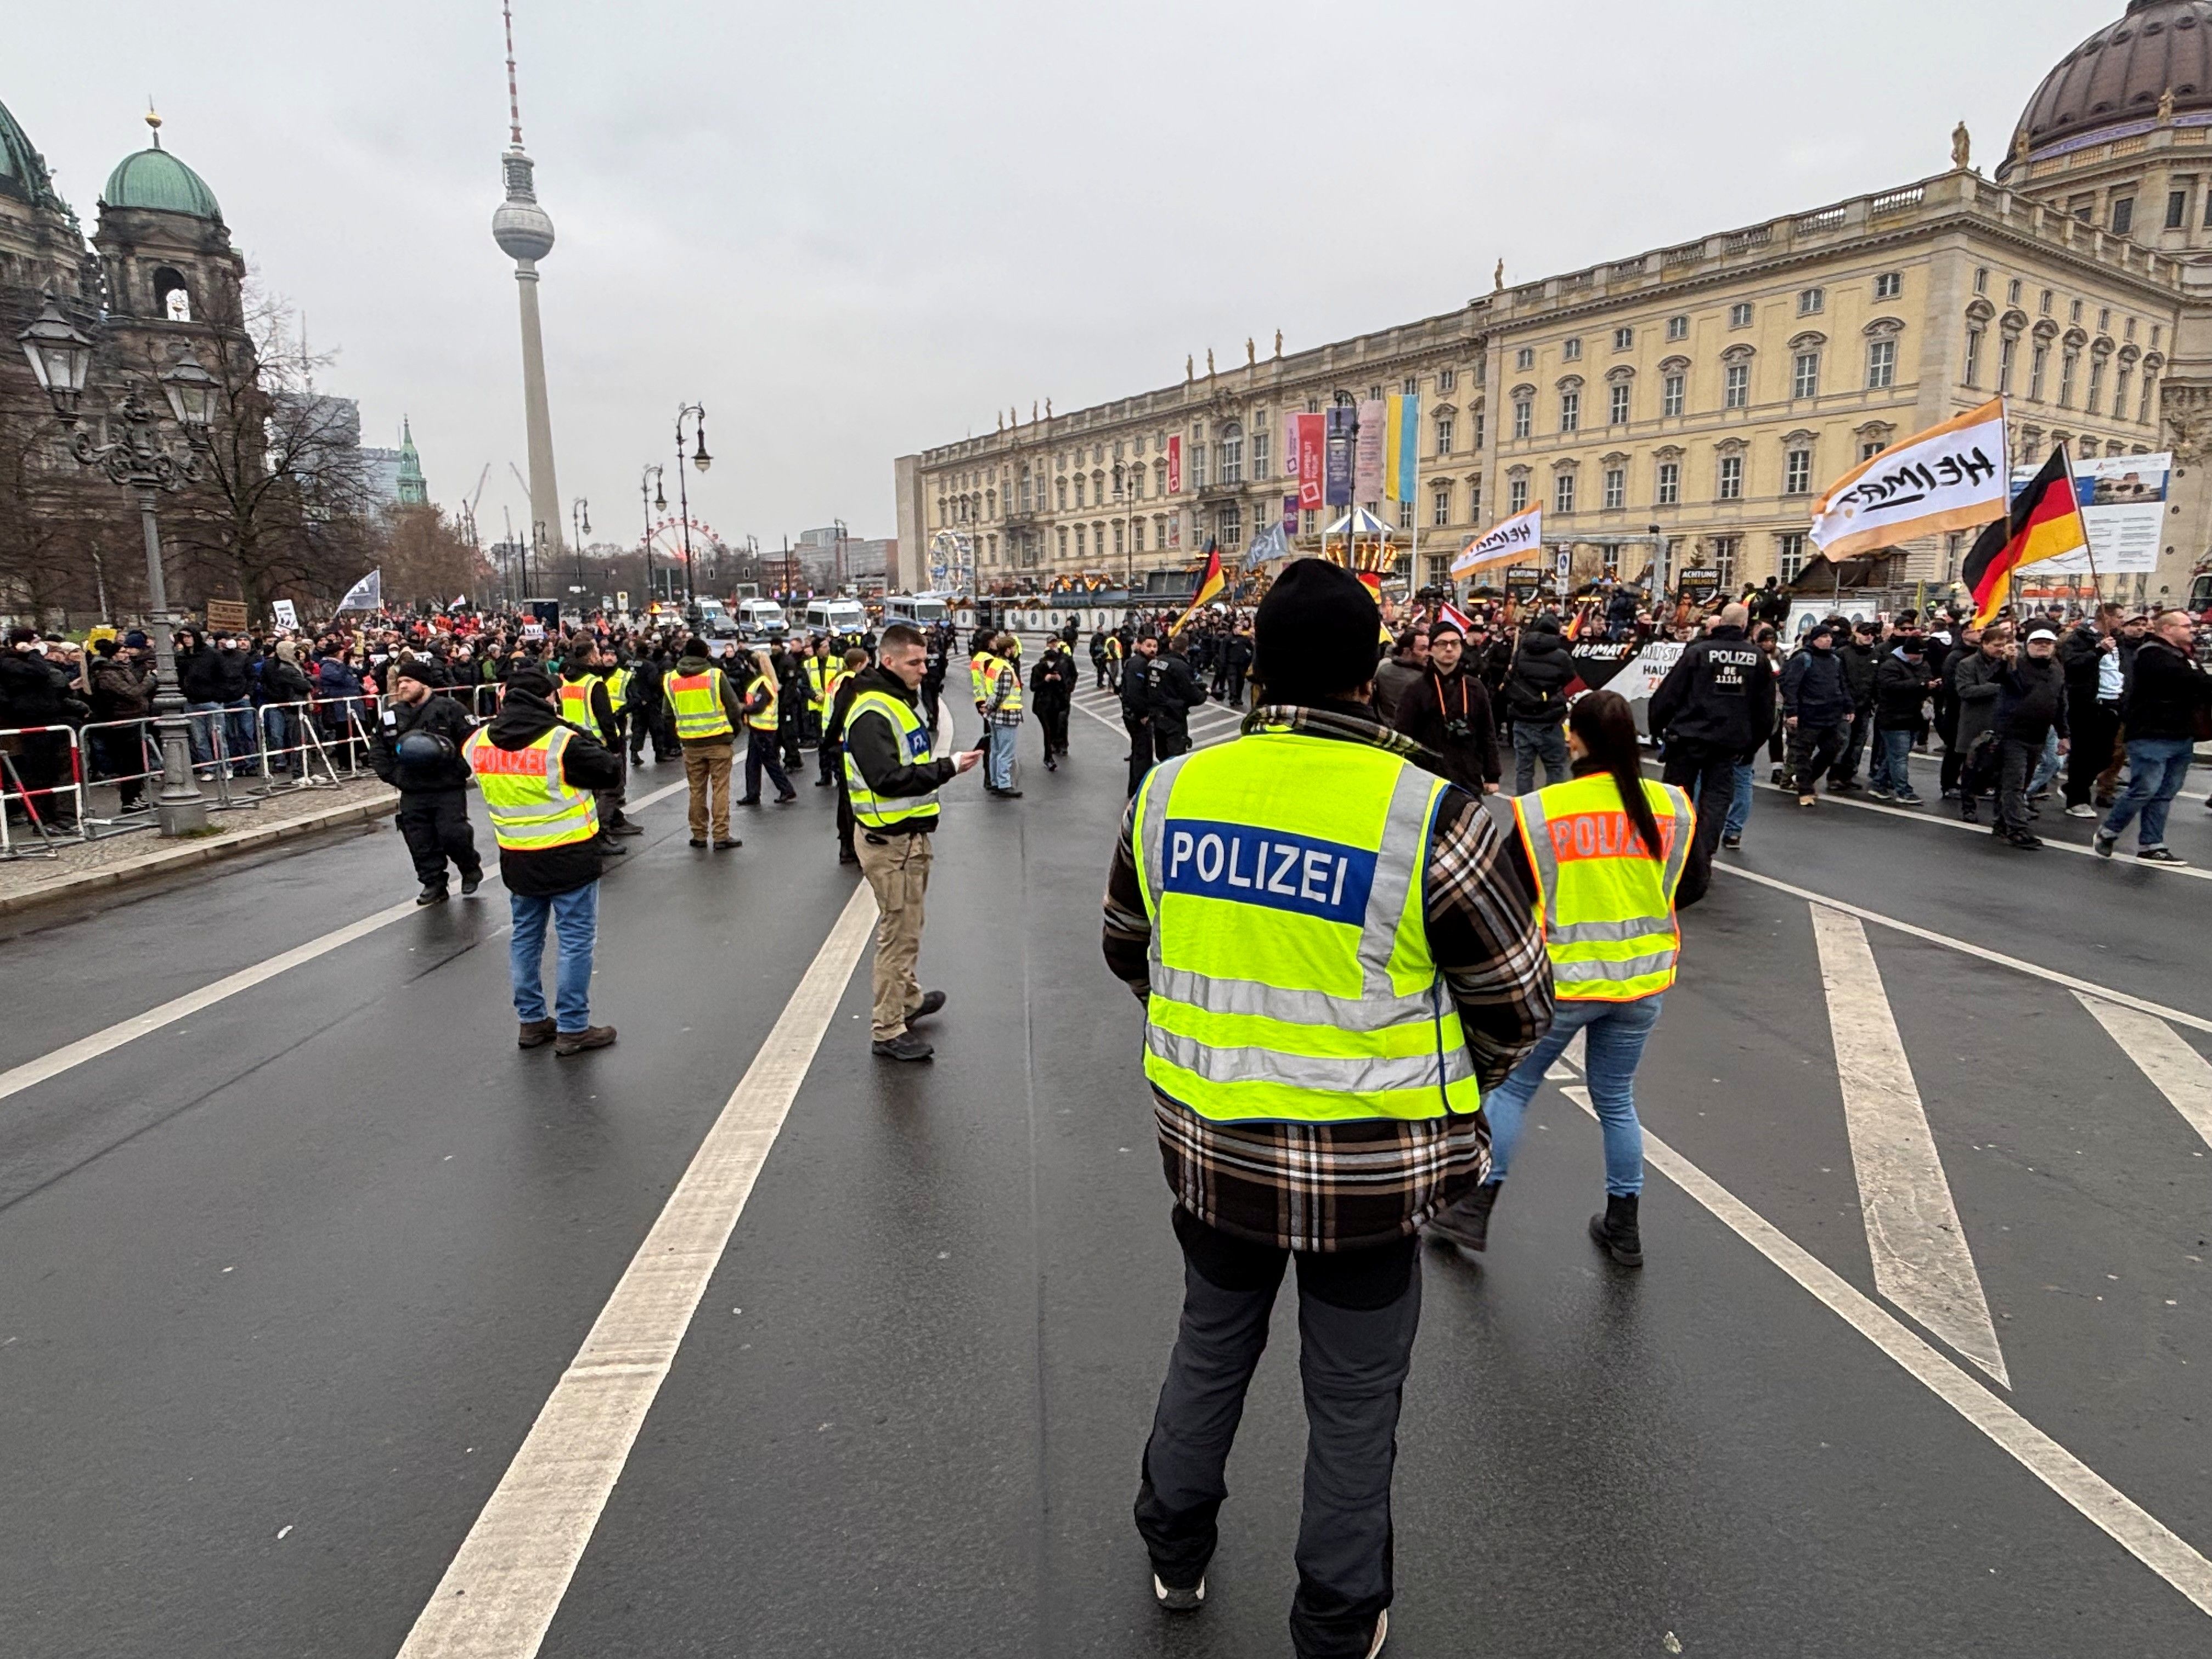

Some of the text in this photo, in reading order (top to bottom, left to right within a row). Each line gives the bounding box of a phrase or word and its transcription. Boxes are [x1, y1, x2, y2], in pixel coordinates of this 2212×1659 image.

[1709, 650, 1757, 666] POLIZEI
[473, 747, 544, 774] POLIZEI
[1171, 831, 1348, 906] POLIZEI
